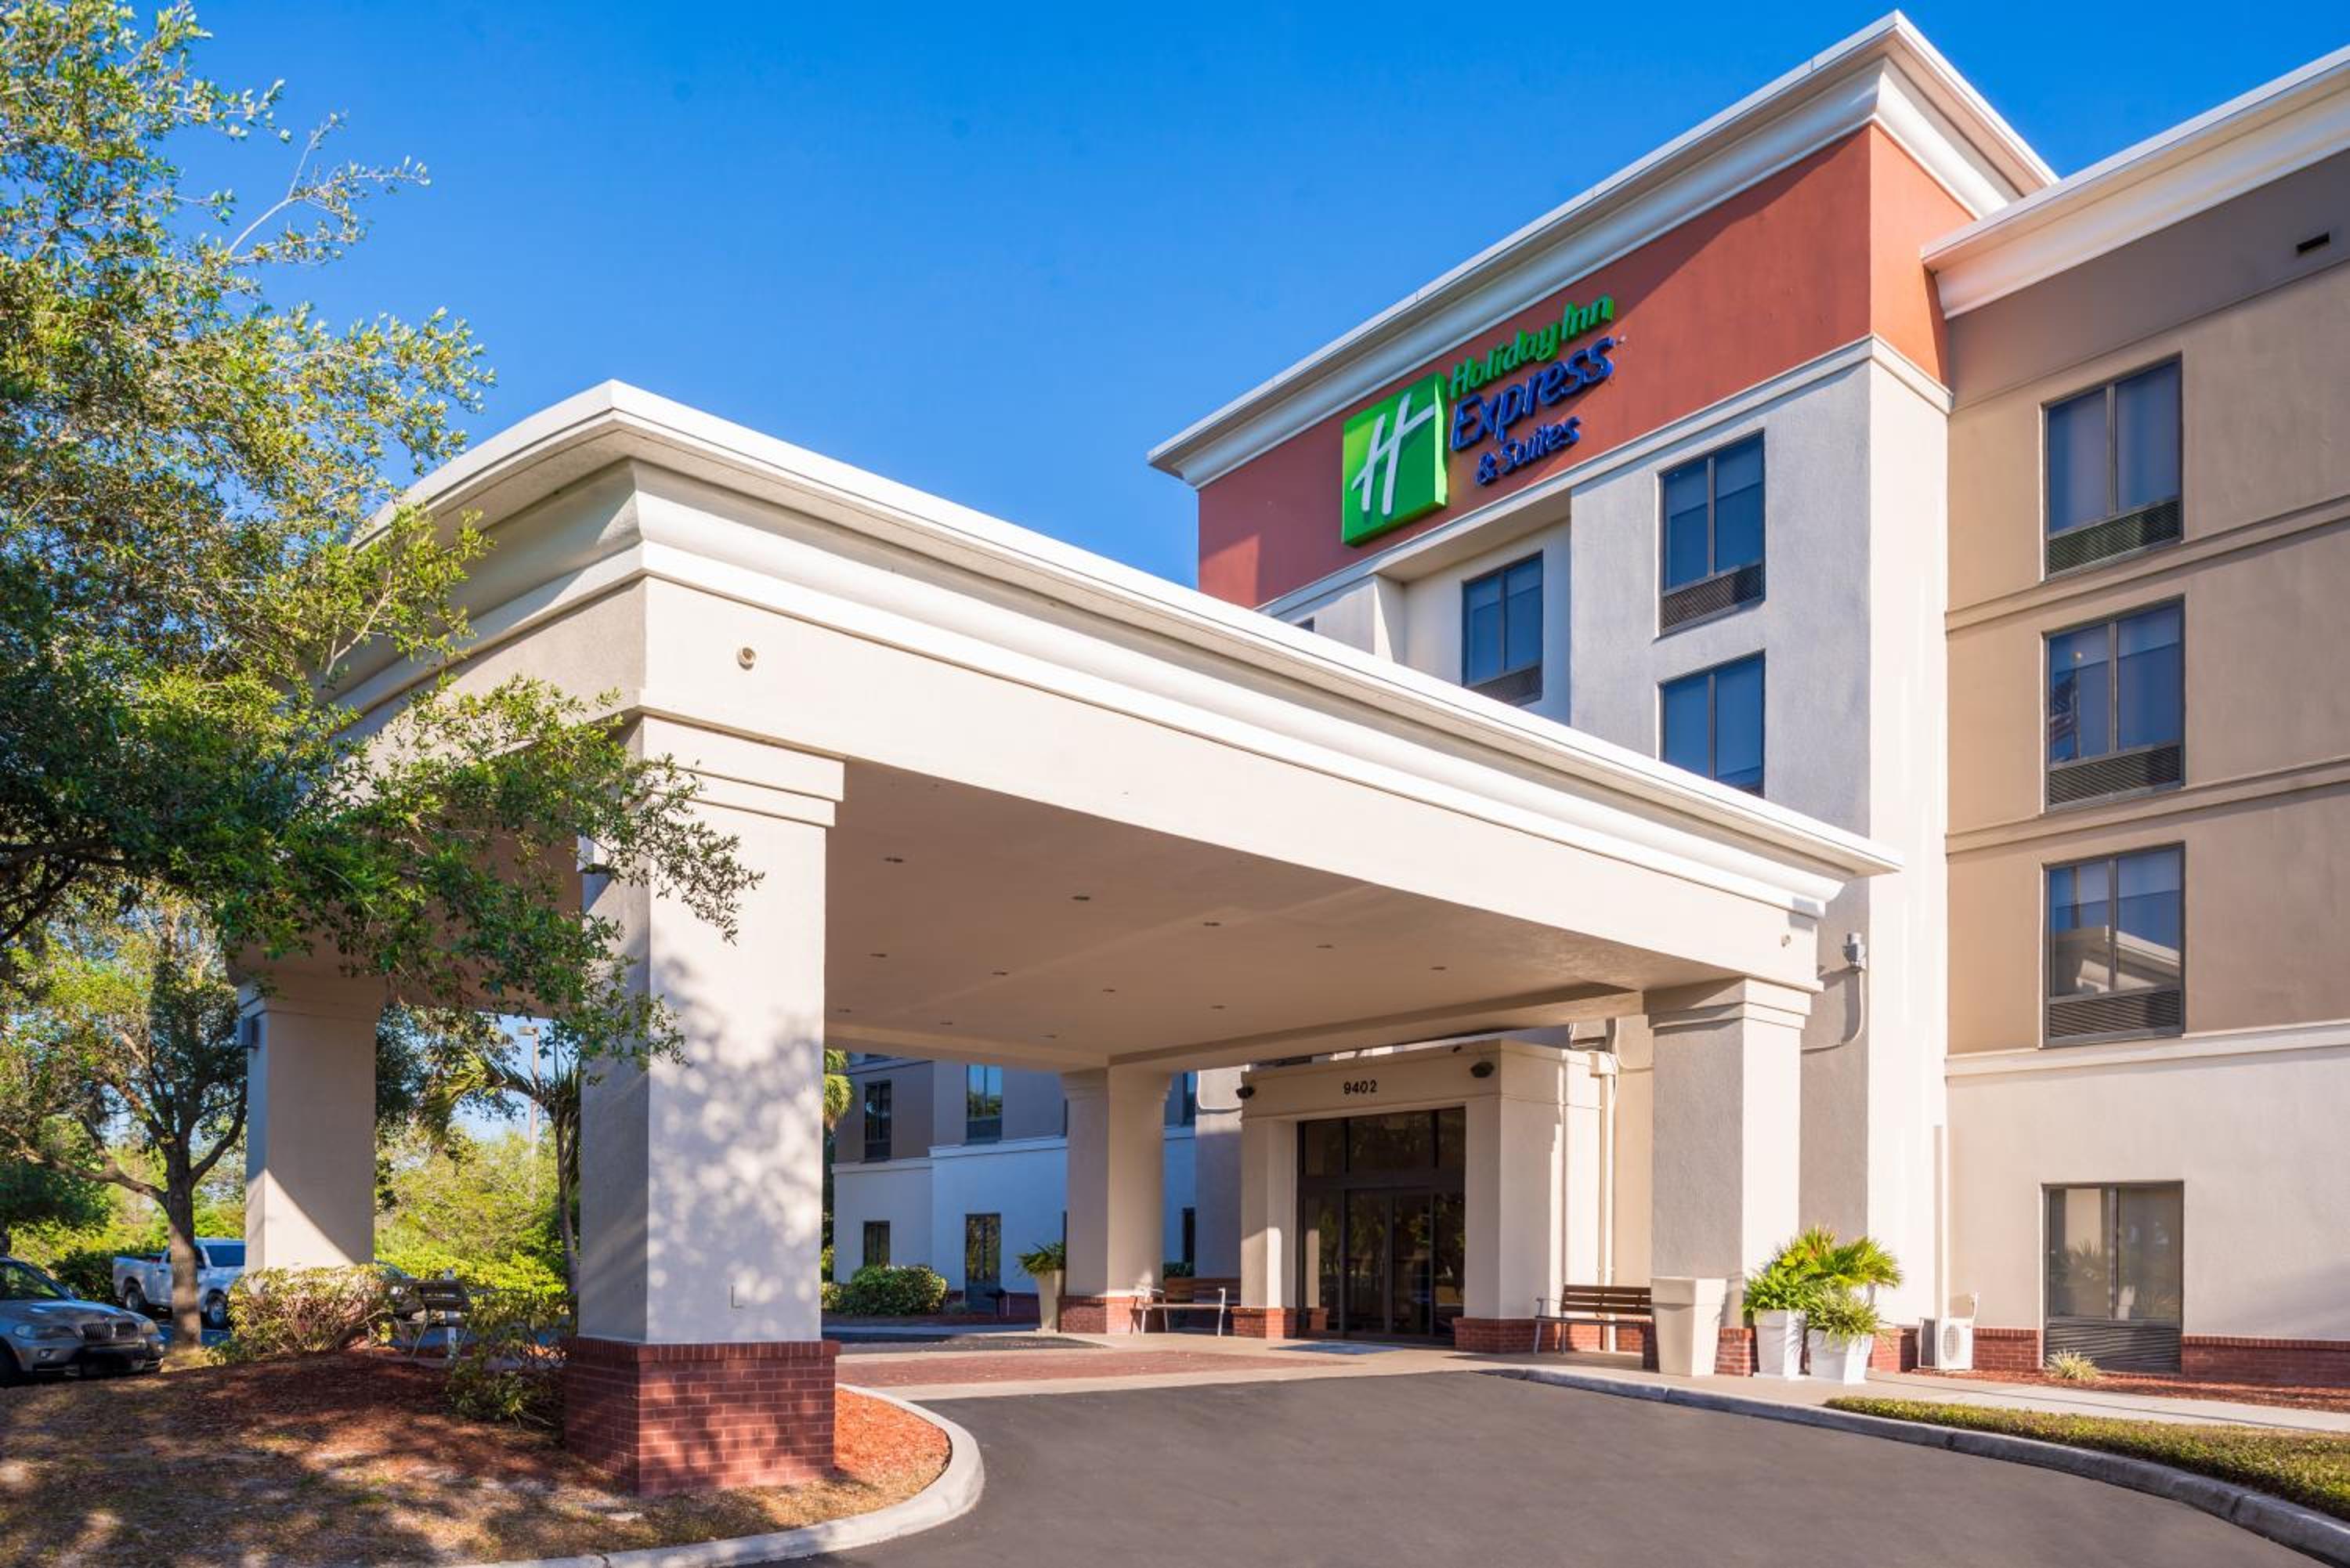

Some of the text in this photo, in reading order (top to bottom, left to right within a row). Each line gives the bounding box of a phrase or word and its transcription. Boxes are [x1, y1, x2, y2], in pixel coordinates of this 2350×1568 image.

[1450, 294, 1614, 400] Holiday Inn
[1449, 336, 1614, 452] Express
[1475, 416, 1582, 486] & Suites
[1343, 1079, 1378, 1096] 9402
